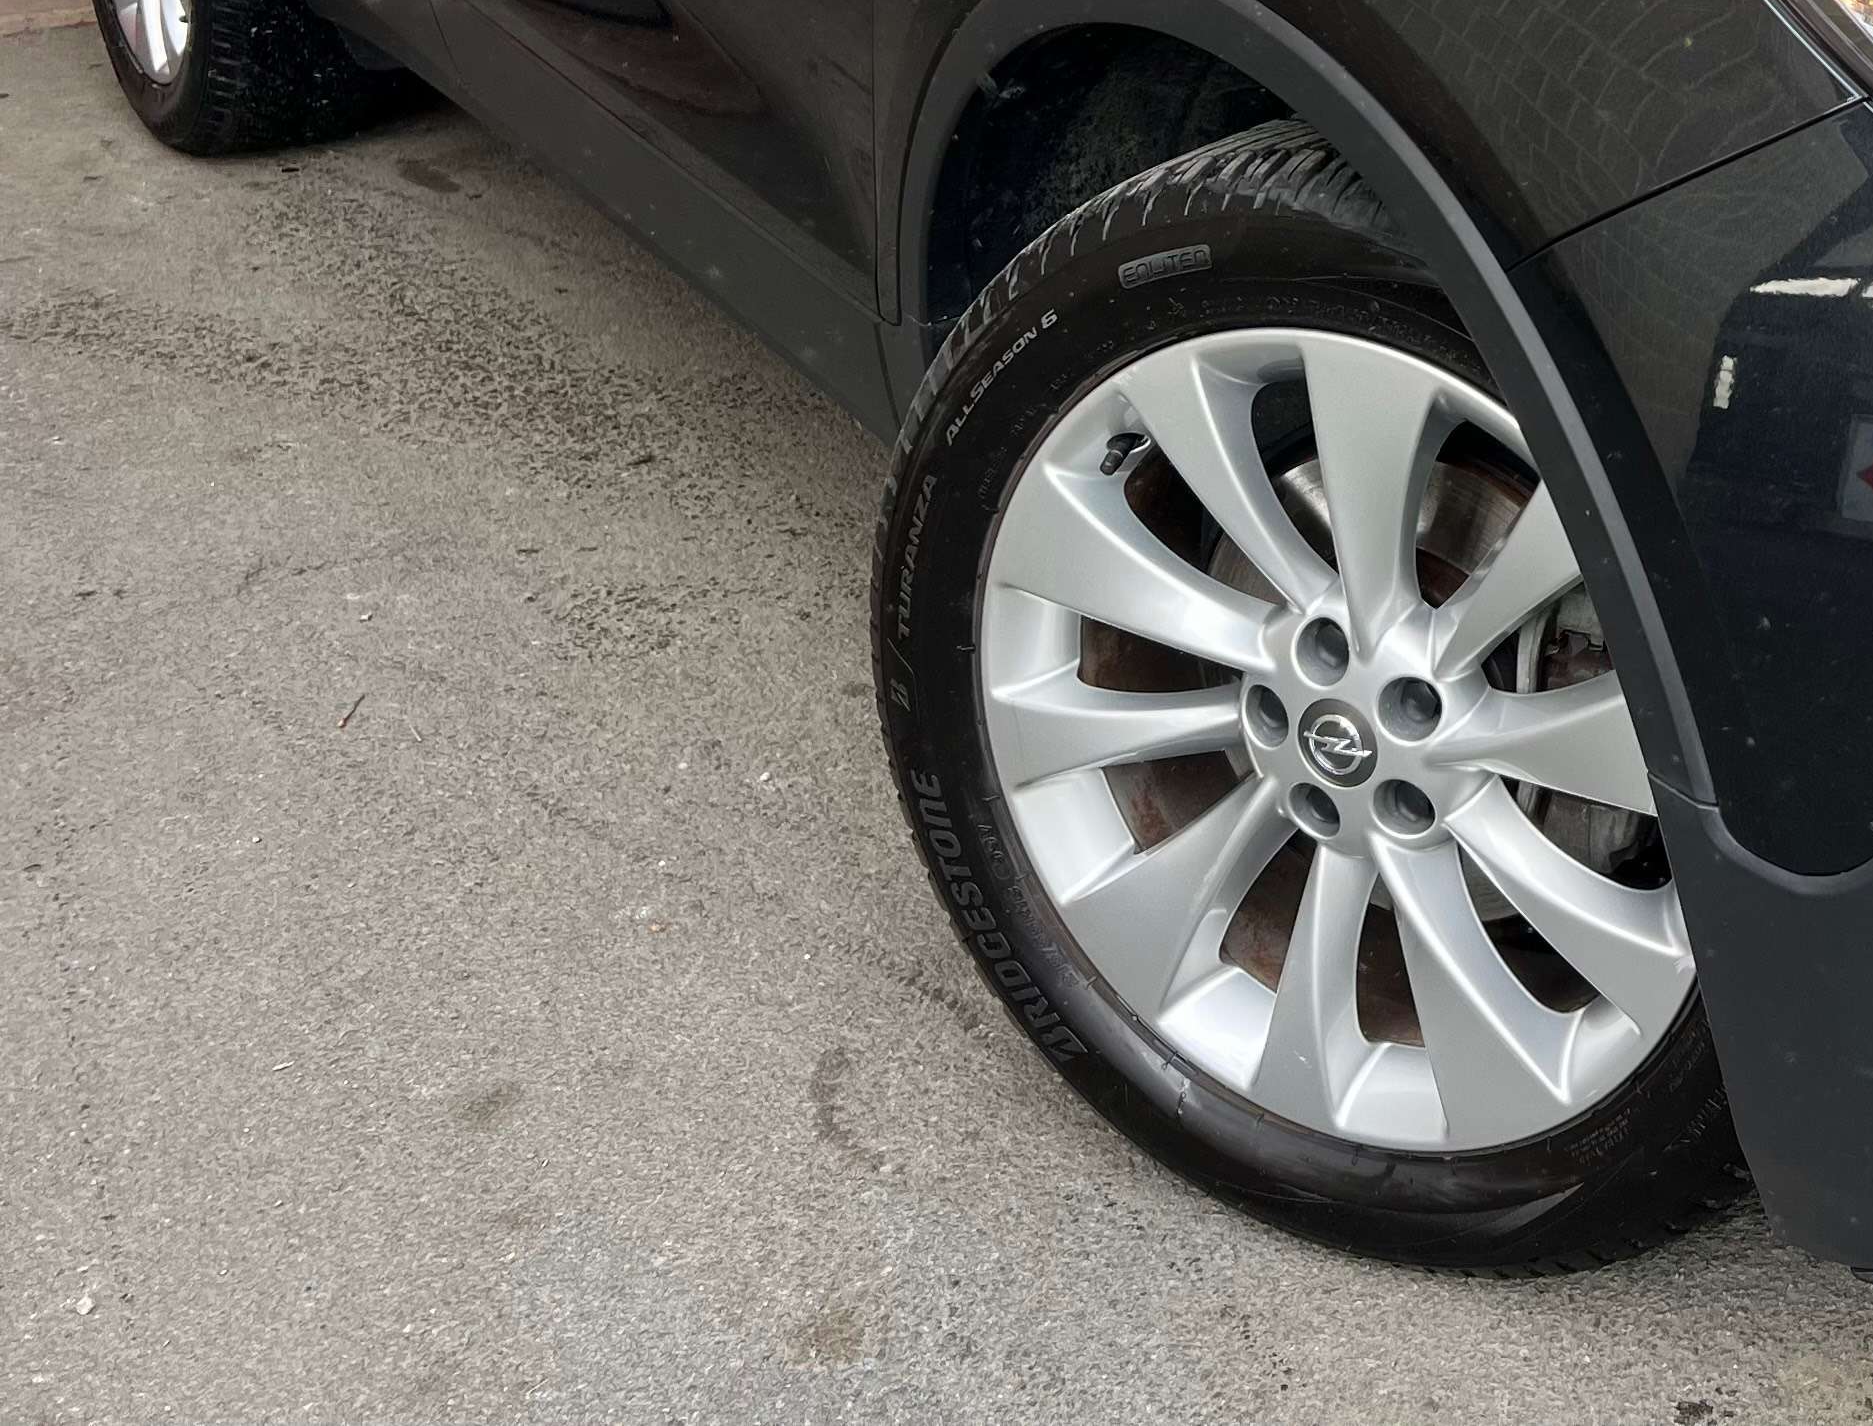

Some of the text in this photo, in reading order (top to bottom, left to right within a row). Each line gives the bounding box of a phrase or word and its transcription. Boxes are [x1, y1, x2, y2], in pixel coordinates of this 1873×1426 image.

[898, 475, 938, 638] TURANZA
[946, 326, 1039, 446] ALLSEASON
[1040, 308, 1059, 330] 6
[911, 769, 1088, 1062] BRIDGESTONE
